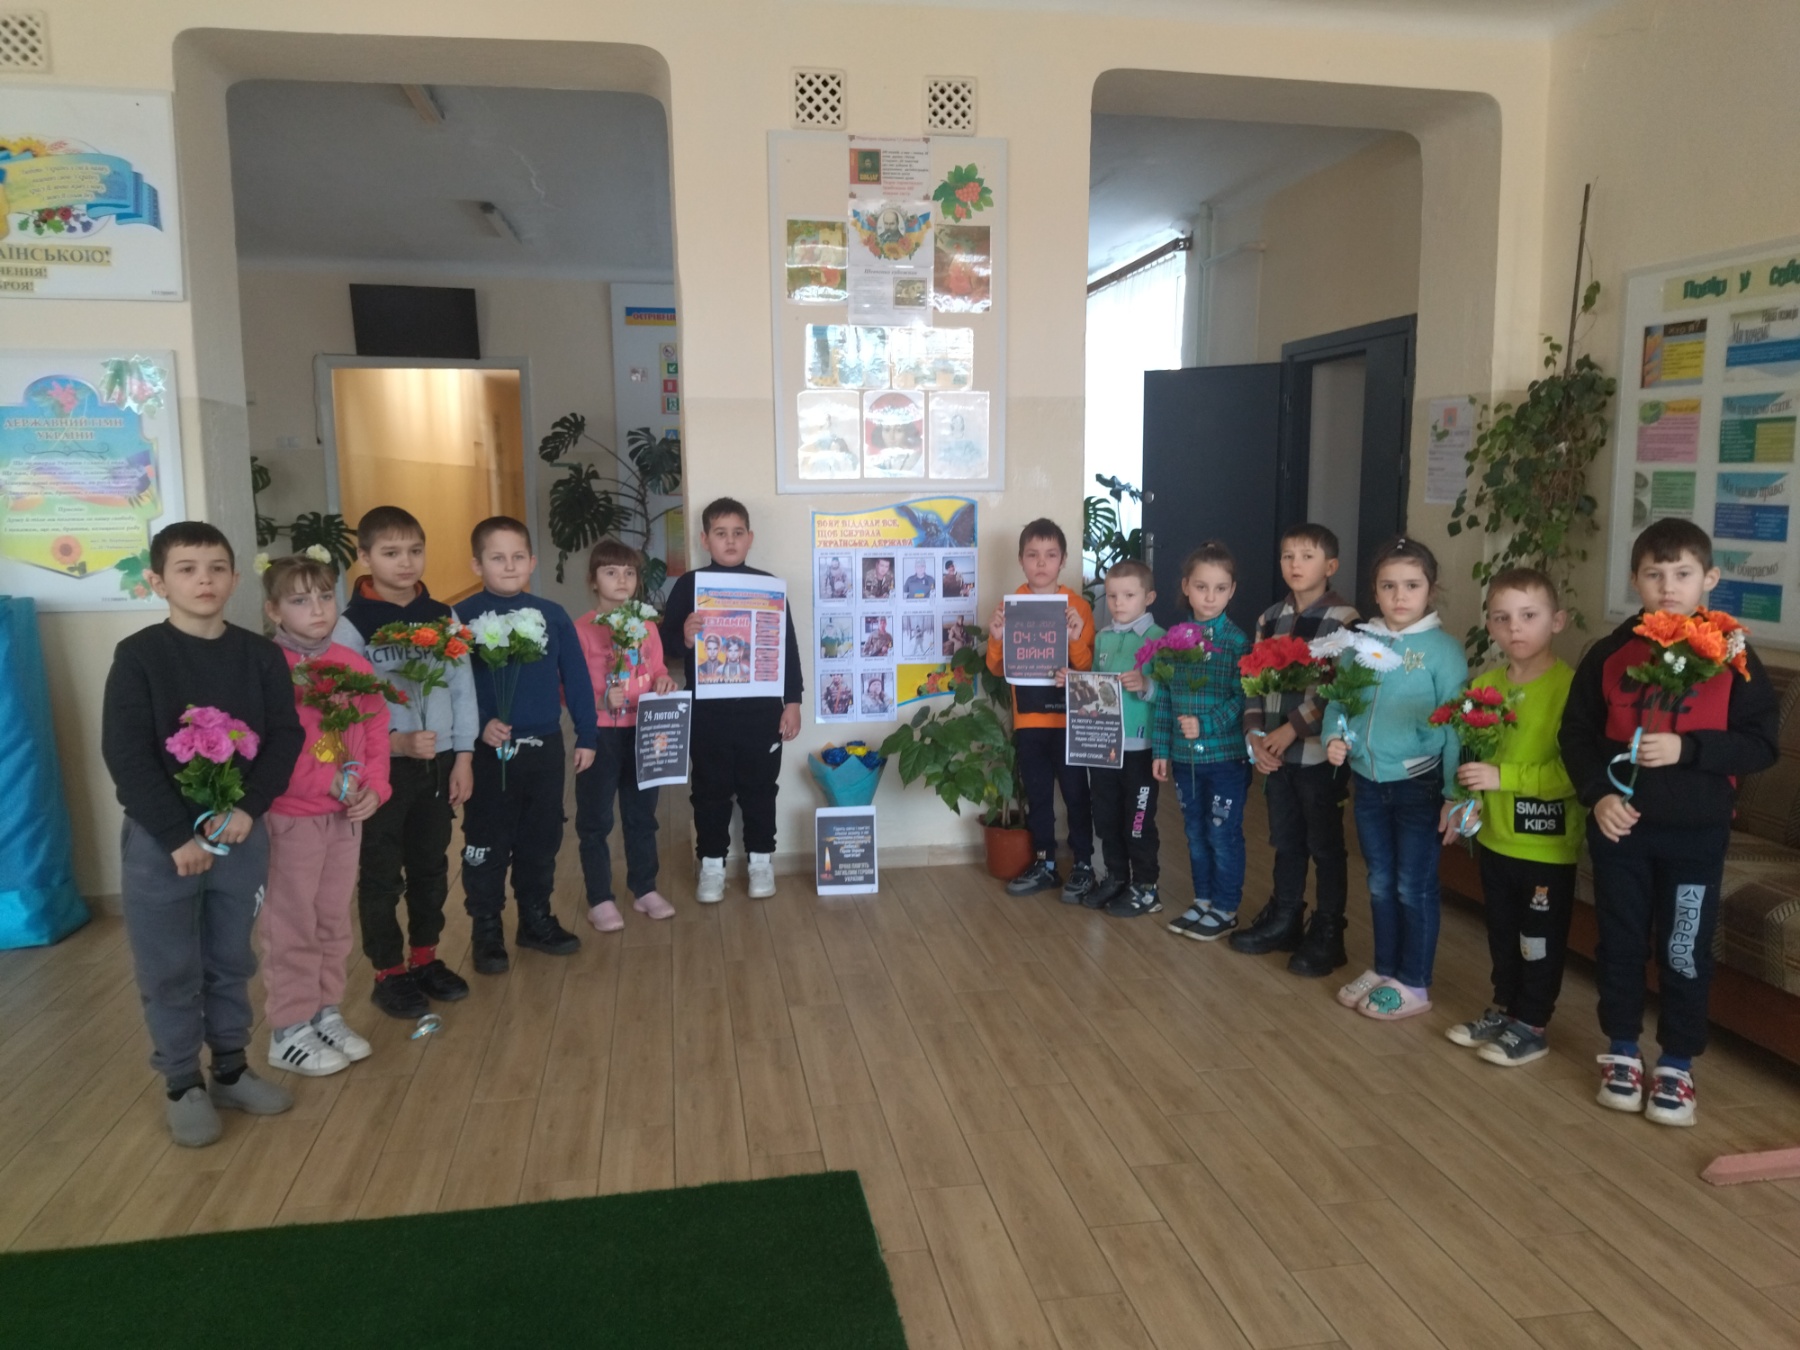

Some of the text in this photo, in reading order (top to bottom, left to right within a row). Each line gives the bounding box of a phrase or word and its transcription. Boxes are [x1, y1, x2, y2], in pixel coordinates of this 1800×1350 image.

[1016, 646, 1055, 660] ВІЙНА
[643, 711, 653, 722] 24
[1516, 801, 1563, 815] SMART
[1524, 818, 1556, 831] KIDS
